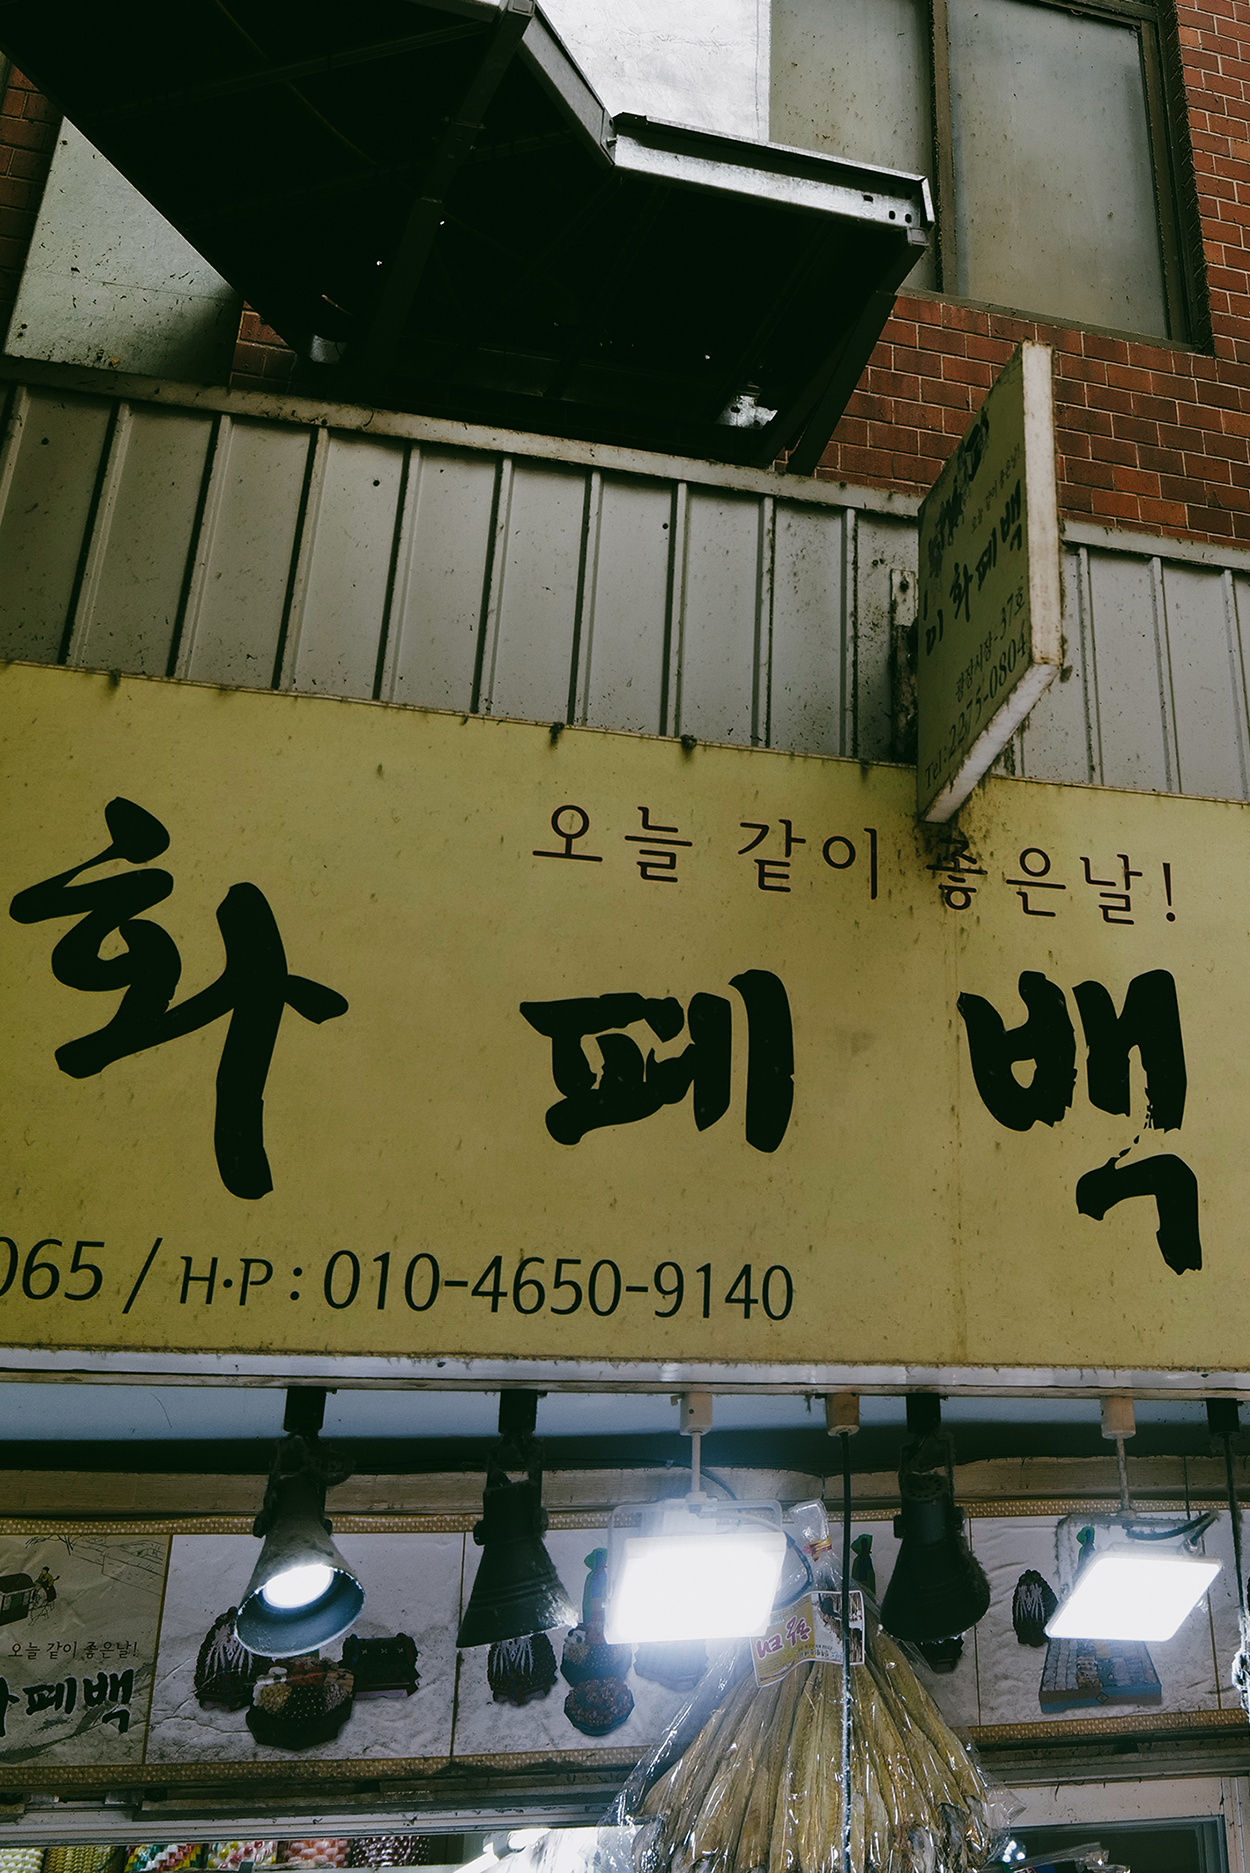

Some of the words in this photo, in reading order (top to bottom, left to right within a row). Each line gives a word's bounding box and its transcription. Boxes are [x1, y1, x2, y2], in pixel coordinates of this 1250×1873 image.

[532, 804, 693, 883] 오늘
[736, 817, 879, 900] 같이
[323, 1249, 795, 1321] 010-4650-9140
[8, 1641, 41, 1660] 오늘
[46, 1640, 78, 1660] 같이
[83, 1639, 139, 1660] 좋은날!
